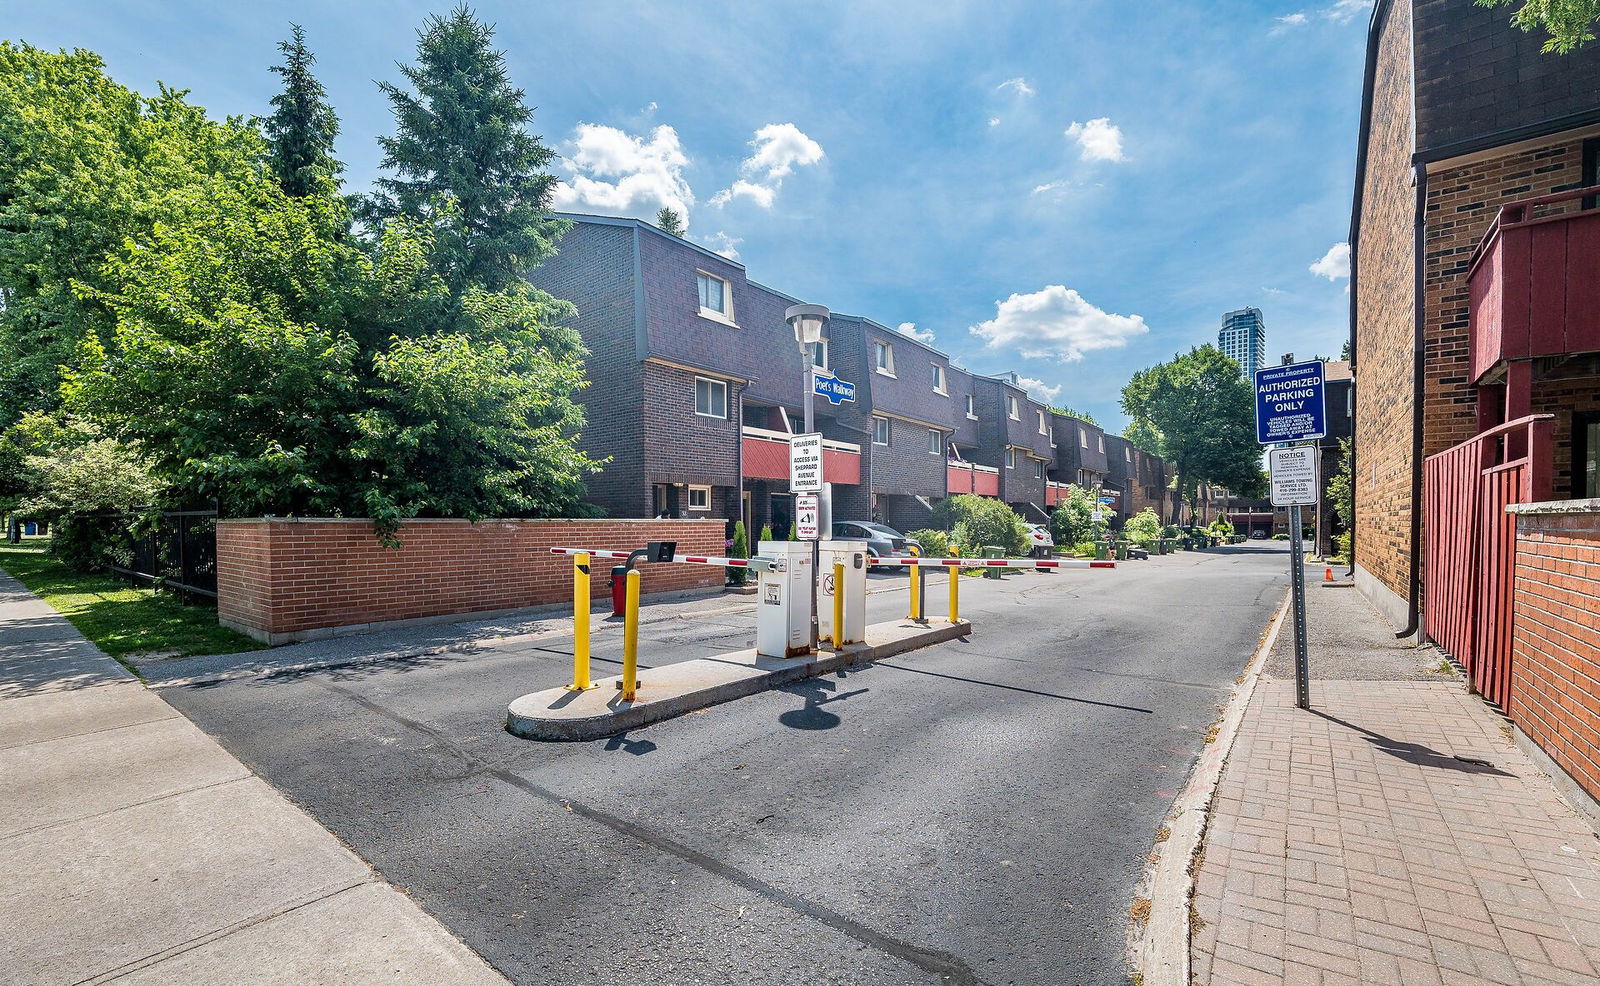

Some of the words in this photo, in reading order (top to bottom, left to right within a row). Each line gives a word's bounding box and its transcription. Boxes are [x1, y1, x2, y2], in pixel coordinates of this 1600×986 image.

[1263, 372, 1284, 380] PRIVATE
[1286, 368, 1314, 376] PROPERTY
[816, 378, 832, 392] Poet's
[833, 382, 854, 399] Walkway
[1259, 377, 1320, 393] AUTHORIZED
[1266, 389, 1314, 403] PARKING
[1275, 401, 1304, 412] ONLY
